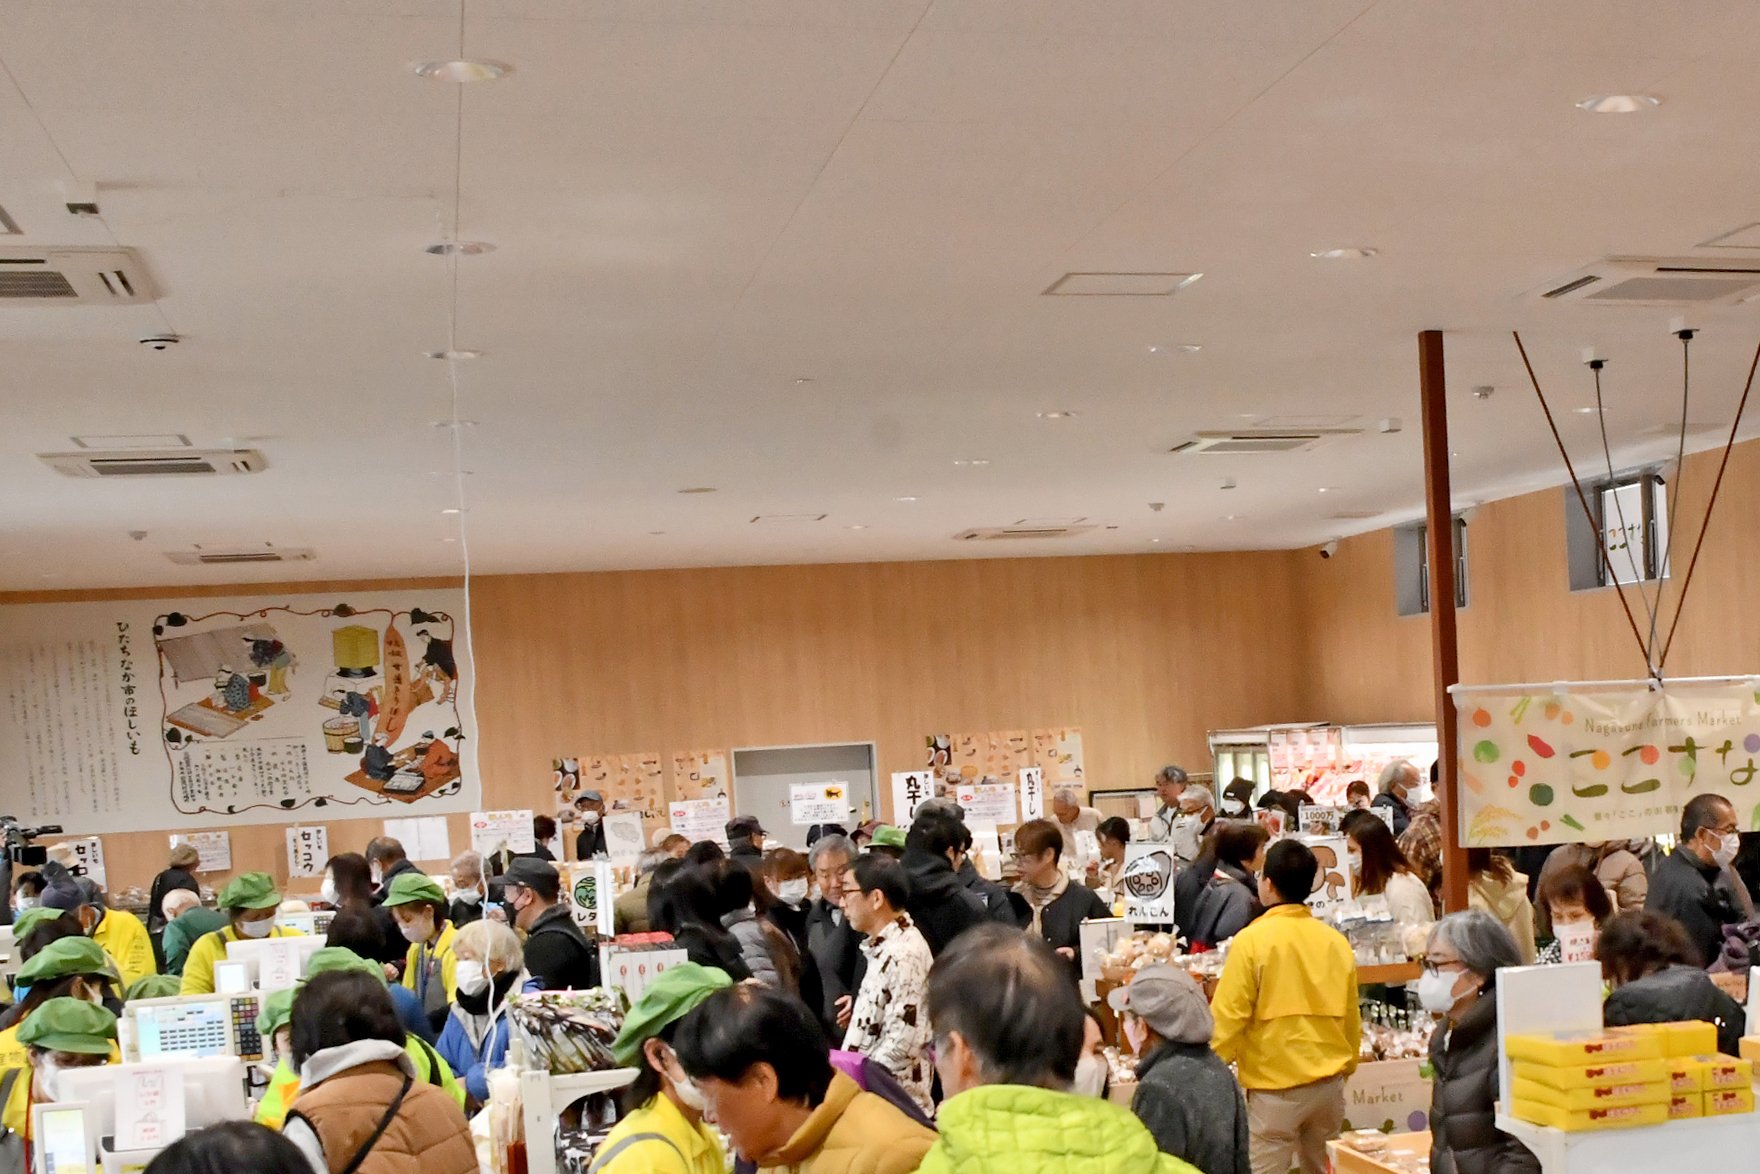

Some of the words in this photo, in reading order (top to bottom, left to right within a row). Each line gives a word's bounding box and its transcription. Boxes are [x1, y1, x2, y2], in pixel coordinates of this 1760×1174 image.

[116, 620, 141, 756] ひたちなか市のほしいも
[1697, 711, 1743, 728] Market
[1568, 734, 1760, 798] ここすな
[1128, 906, 1170, 918] れんこん
